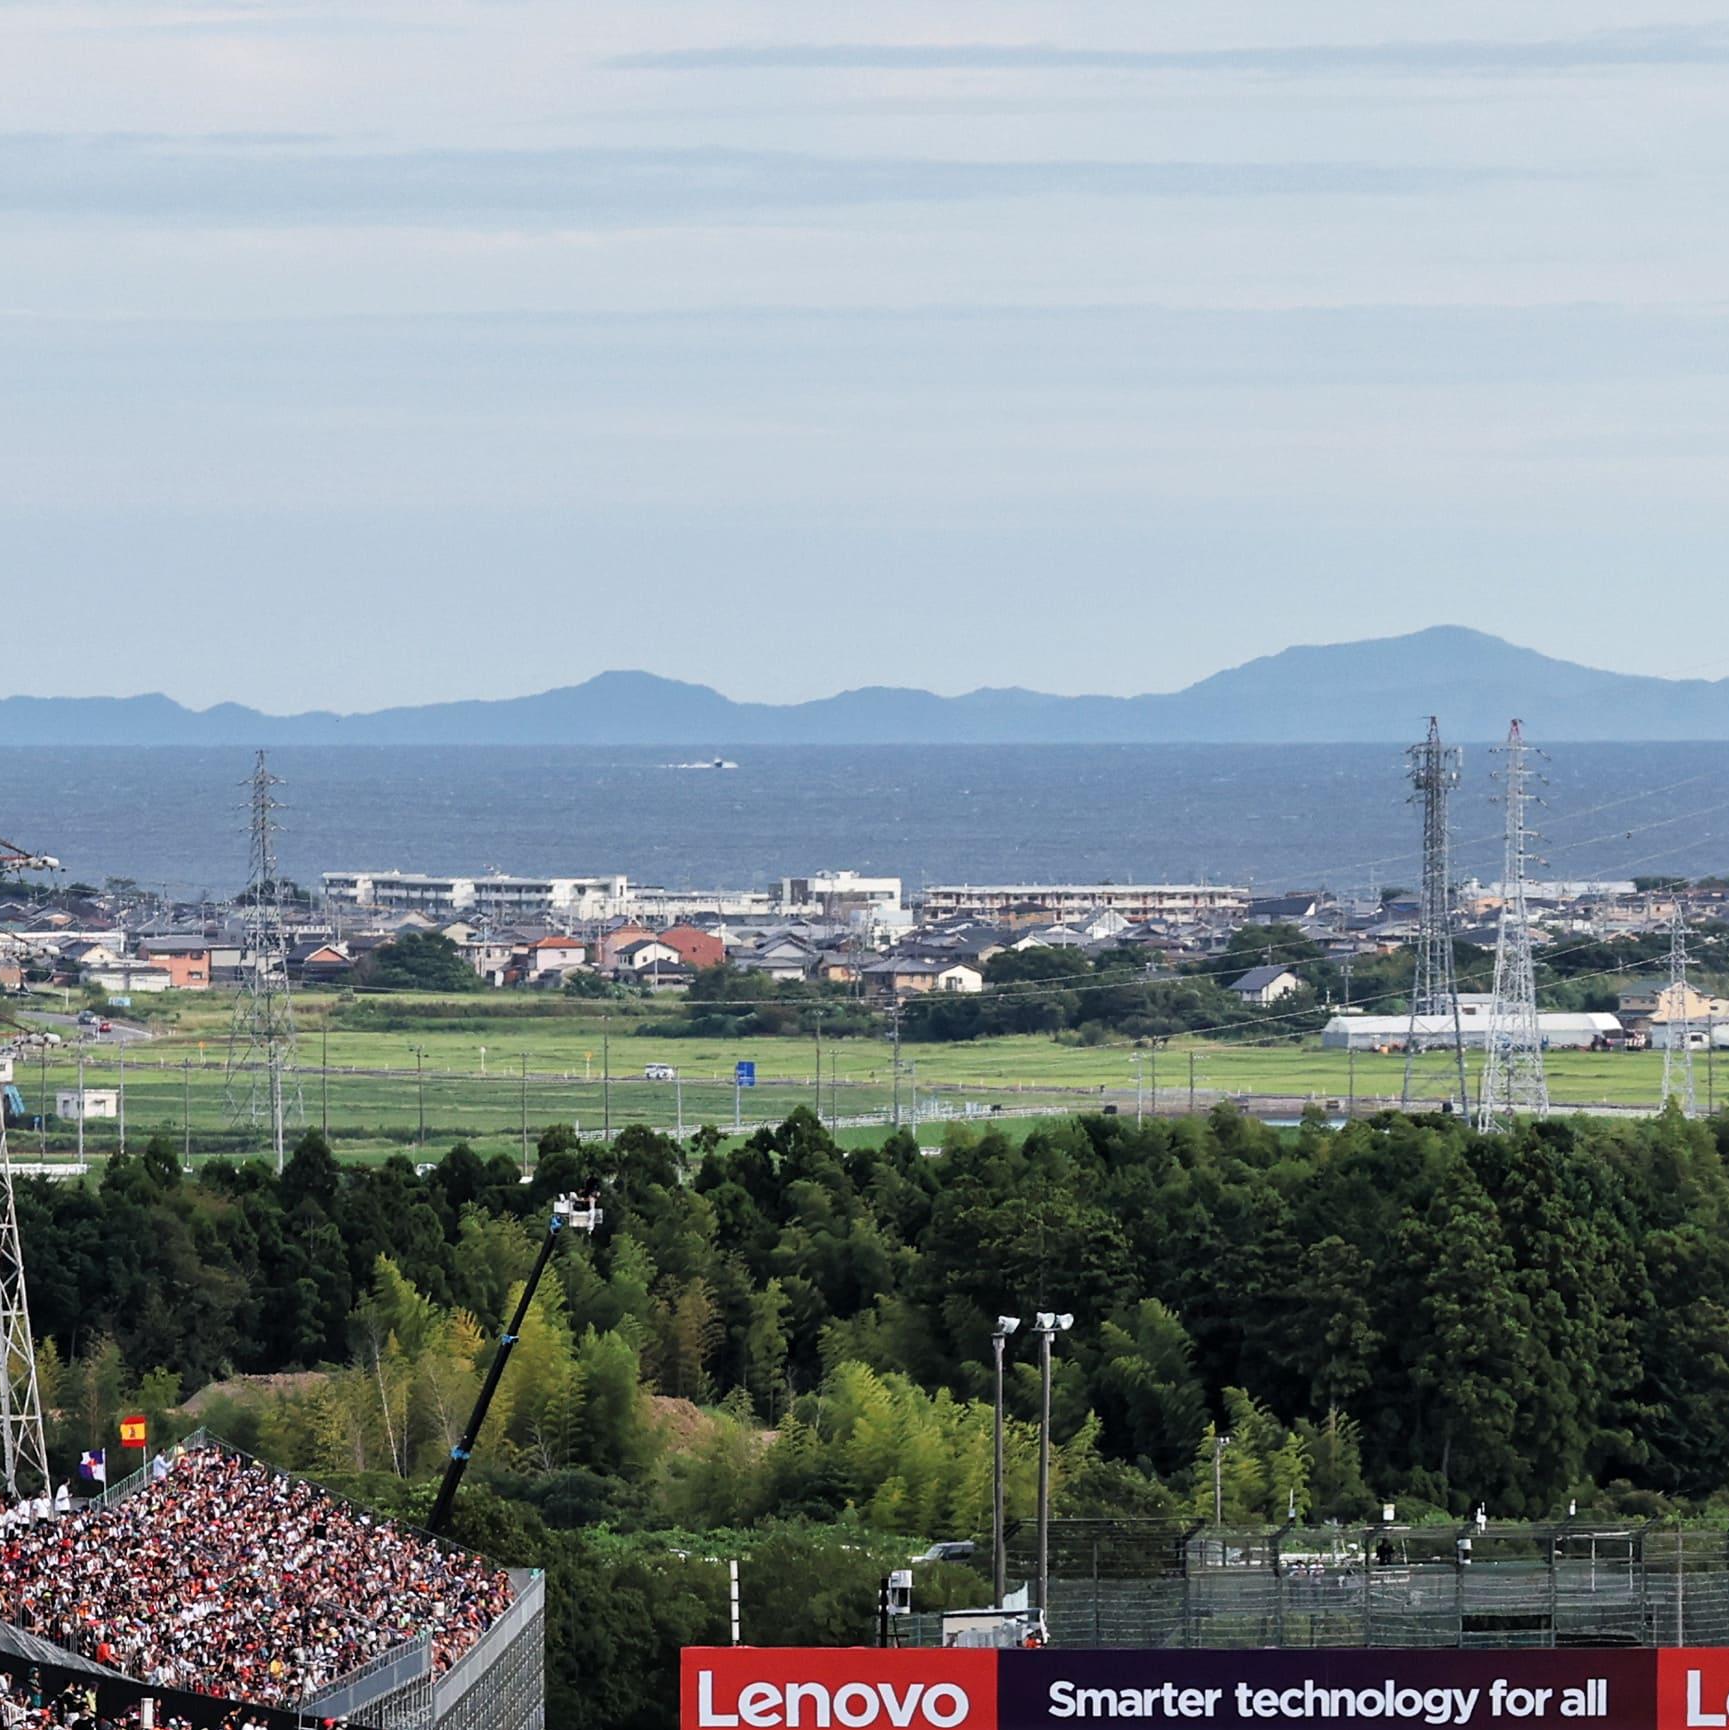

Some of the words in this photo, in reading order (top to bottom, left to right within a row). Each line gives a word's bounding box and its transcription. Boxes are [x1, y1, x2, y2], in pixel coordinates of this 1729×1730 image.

[698, 1670, 969, 1729] Lenovo
[1048, 1681, 1222, 1718] Smarter
[1235, 1680, 1479, 1724] technology
[1489, 1679, 1552, 1717] for
[1560, 1679, 1607, 1717] all
